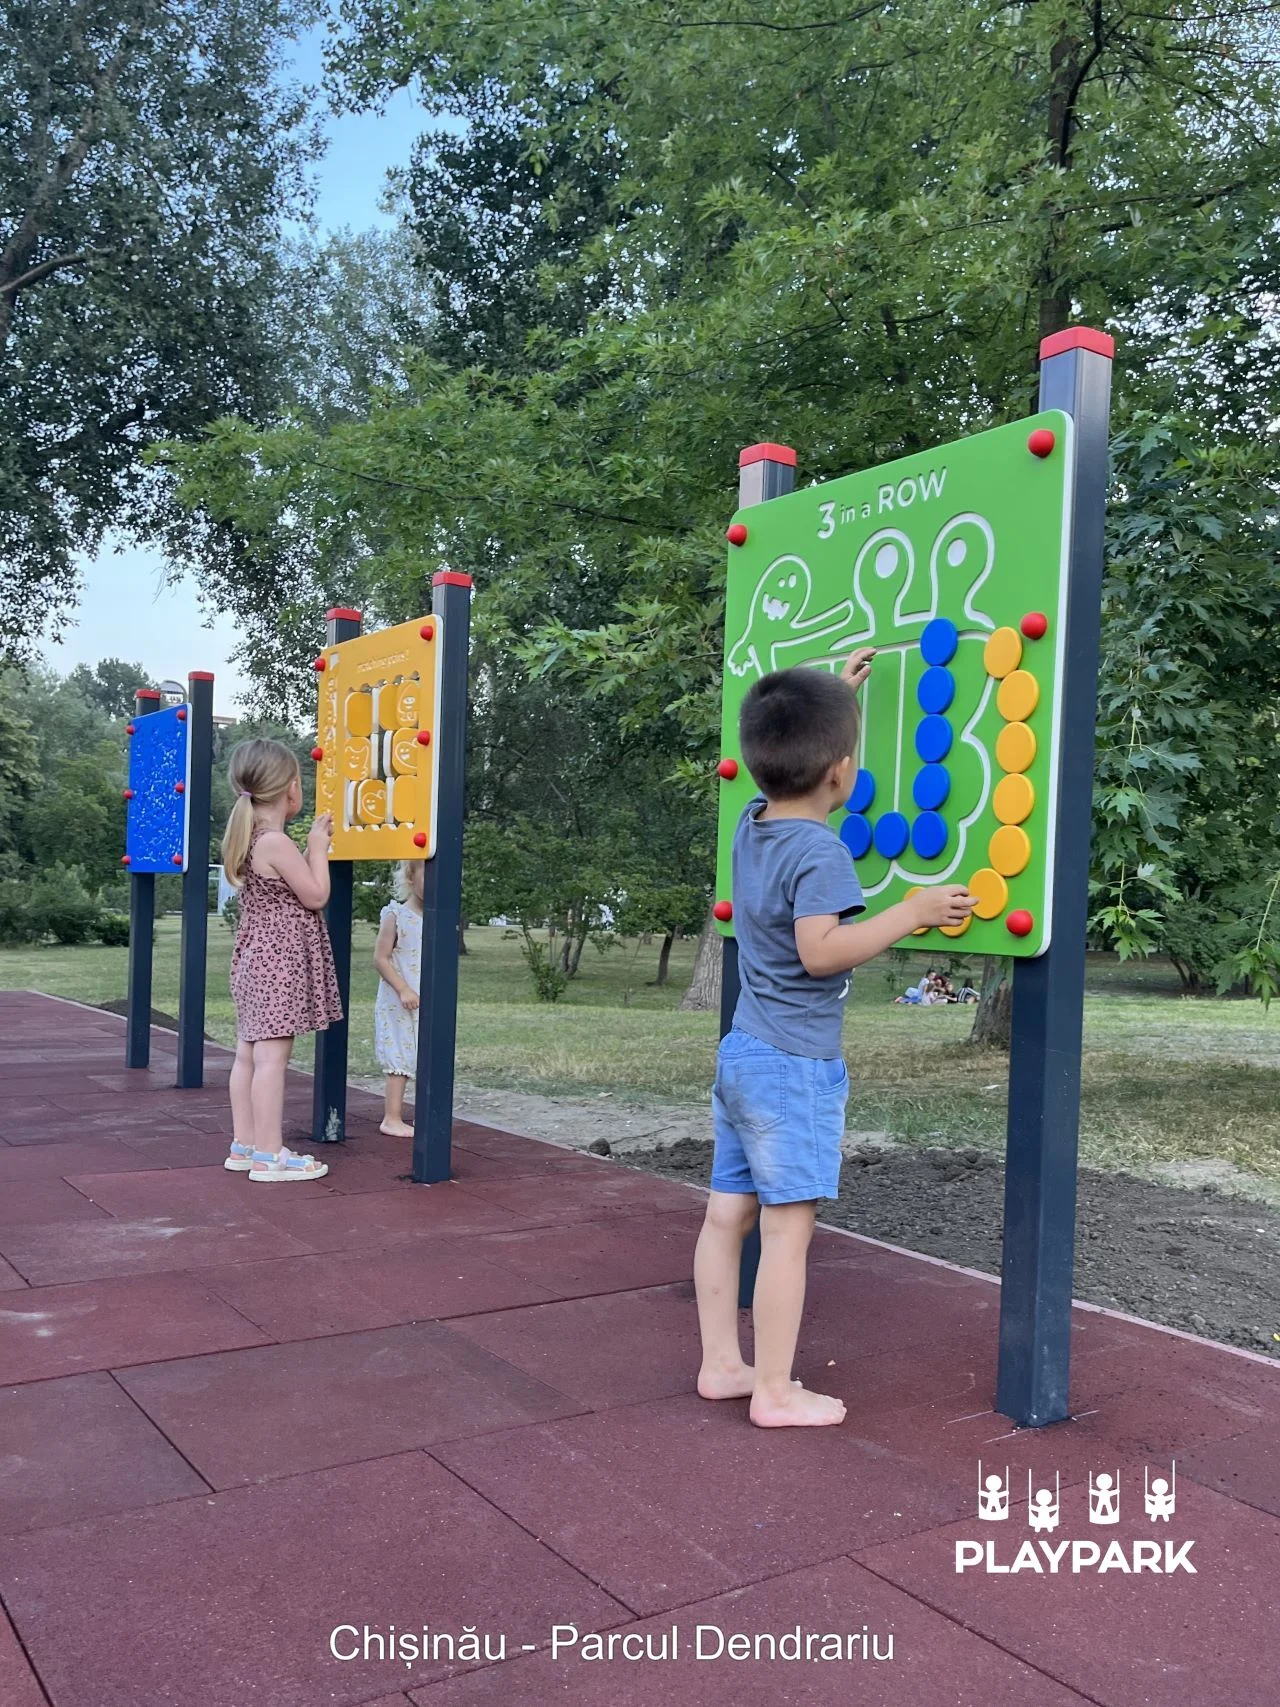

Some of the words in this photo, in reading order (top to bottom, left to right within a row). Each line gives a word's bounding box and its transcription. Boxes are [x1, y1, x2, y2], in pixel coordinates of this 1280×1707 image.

[817, 500, 836, 539] 3
[839, 503, 855, 525] in
[861, 502, 871, 519] a
[878, 466, 947, 514] ROW
